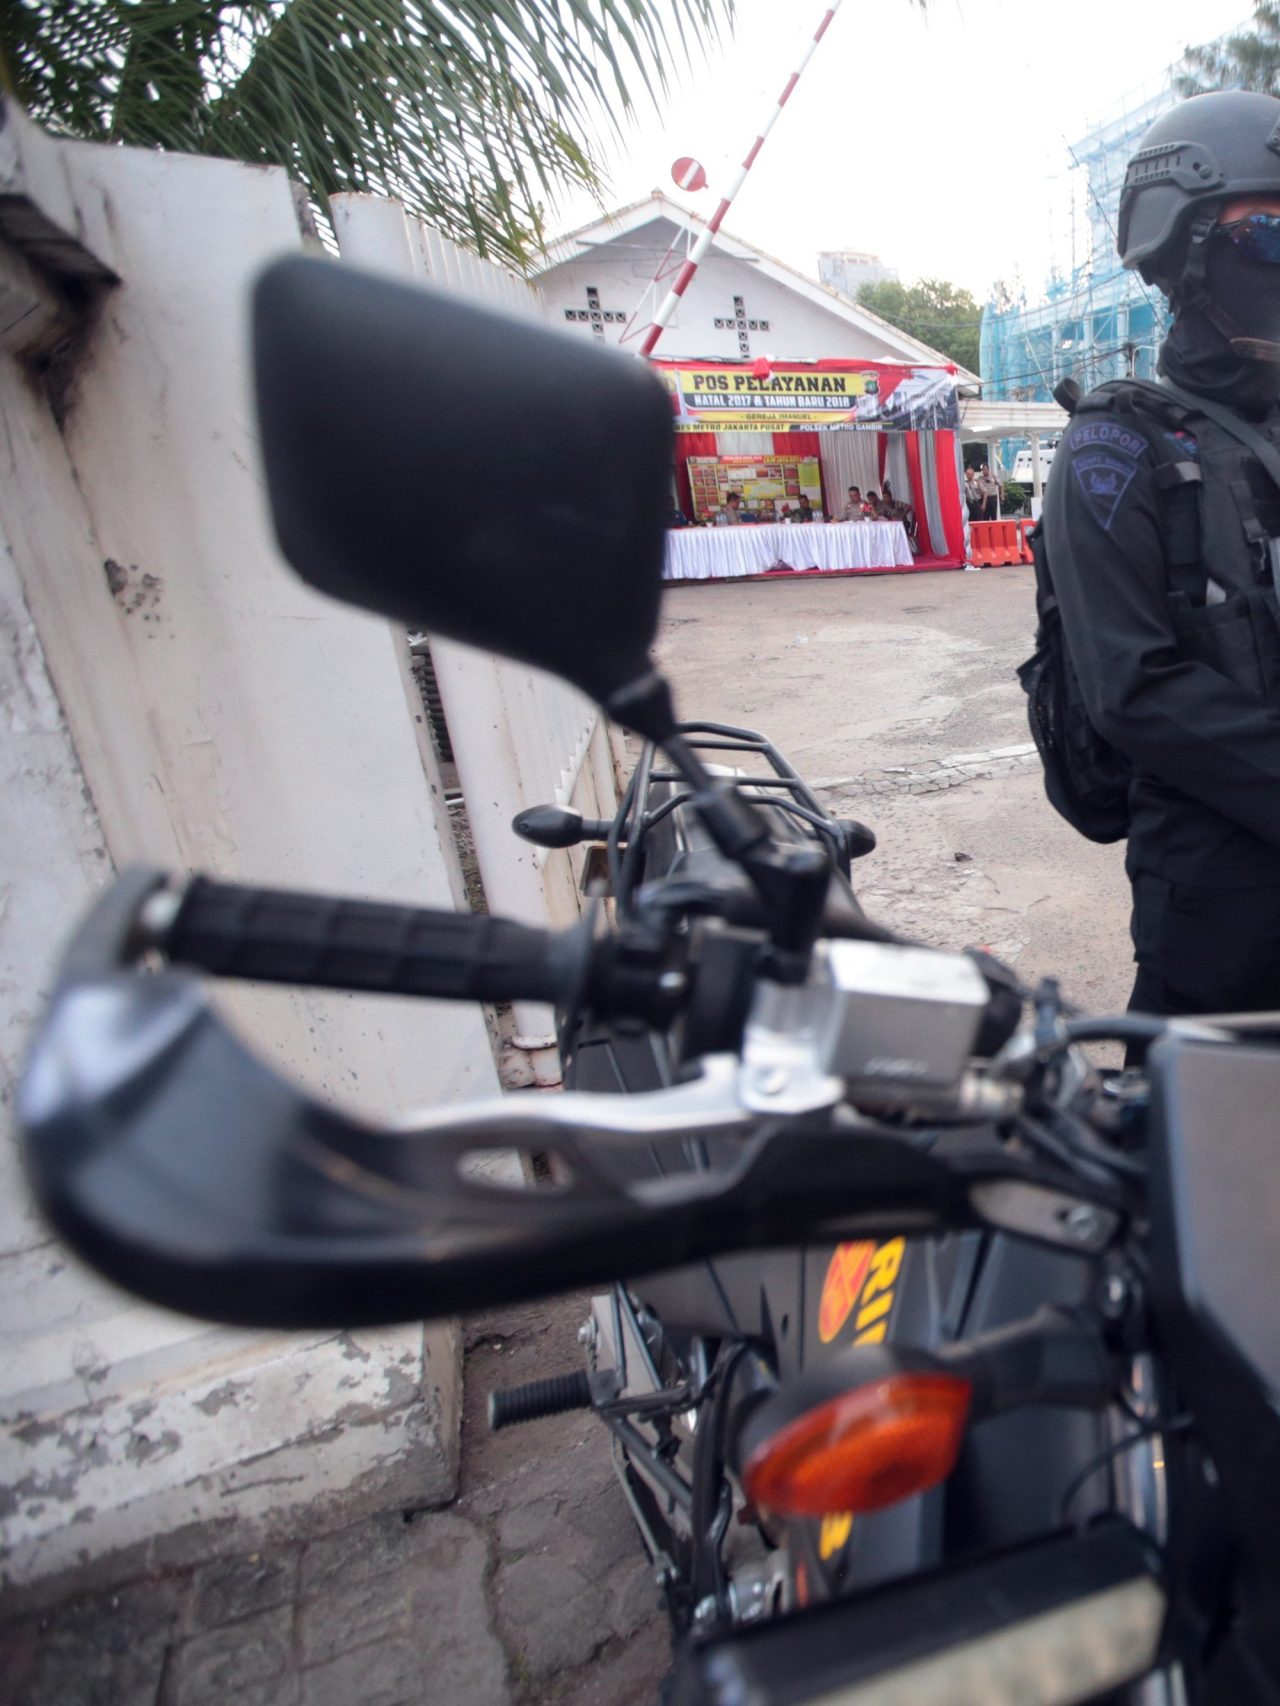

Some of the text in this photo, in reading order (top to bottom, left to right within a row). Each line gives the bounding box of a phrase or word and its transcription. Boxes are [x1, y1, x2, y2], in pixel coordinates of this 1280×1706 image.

[693, 375, 846, 392] POS PELAYANAN
[694, 394, 726, 407] NATAL
[728, 395, 751, 407] 2017
[764, 395, 796, 408] TAHUN
[798, 396, 825, 408] BARU
[826, 396, 850, 409] 2018
[746, 413, 812, 421] GEREJA IMANUEL
[673, 423, 784, 431] RES METRO JAKARTA PUSAT
[800, 423, 828, 431] POLSEK
[855, 423, 883, 431] GAMBIR
[1071, 426, 1141, 452] PELOPOR
